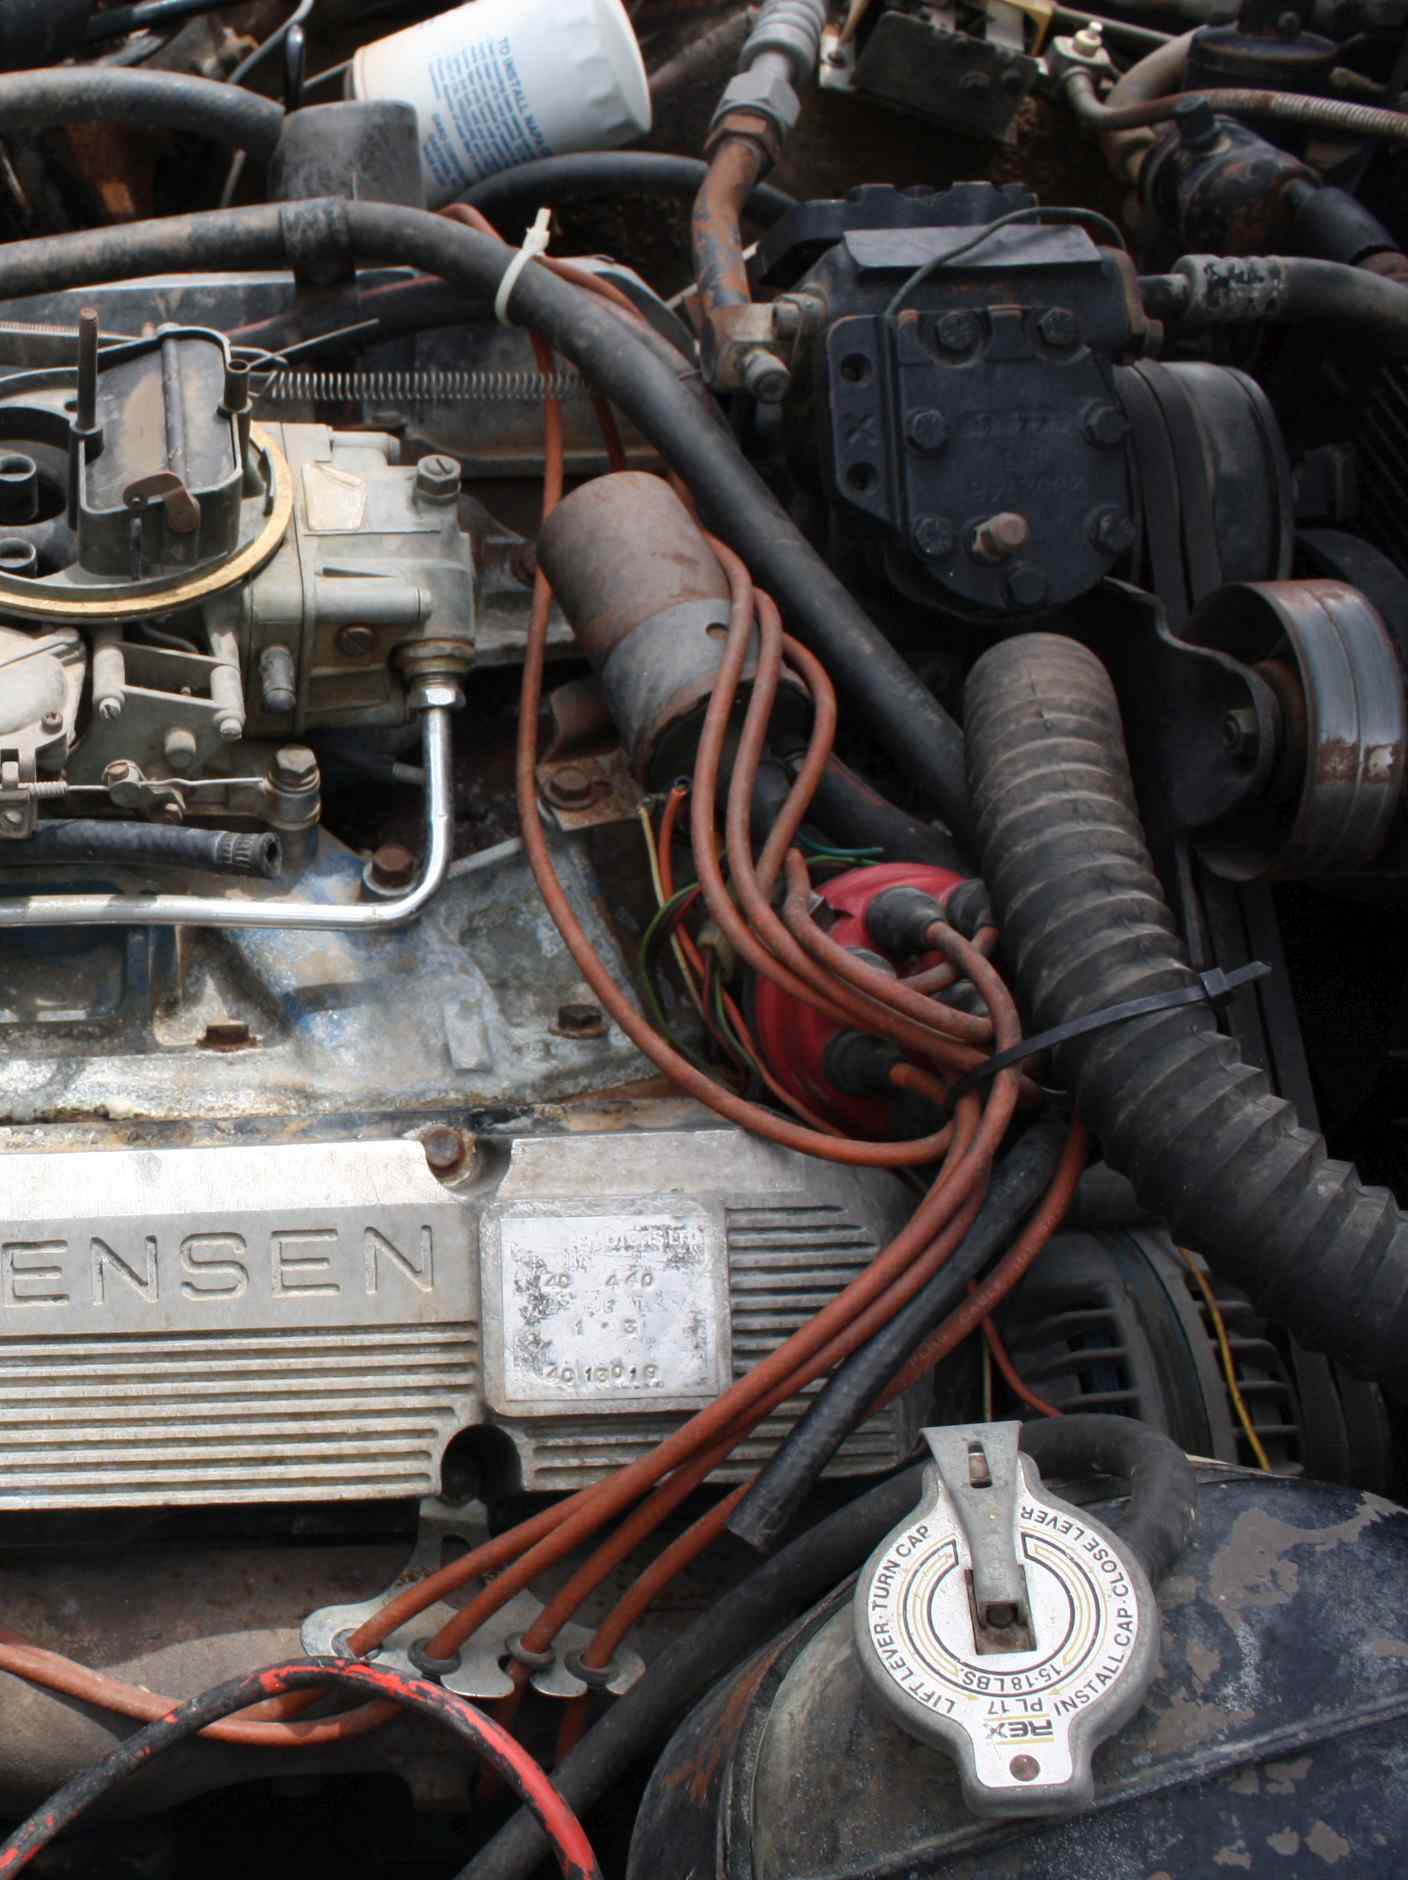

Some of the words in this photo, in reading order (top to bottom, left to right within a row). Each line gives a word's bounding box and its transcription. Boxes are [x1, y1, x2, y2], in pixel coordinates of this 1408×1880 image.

[1020, 1506, 1085, 1541] LEVER
[896, 1525, 930, 1558] CAP
[908, 1682, 956, 1714] LIFT
[1053, 1654, 1125, 1716] INSTALL
[987, 1700, 1010, 1715] 17
[1016, 1697, 1043, 1713] PL
[985, 1719, 1054, 1738] REX
